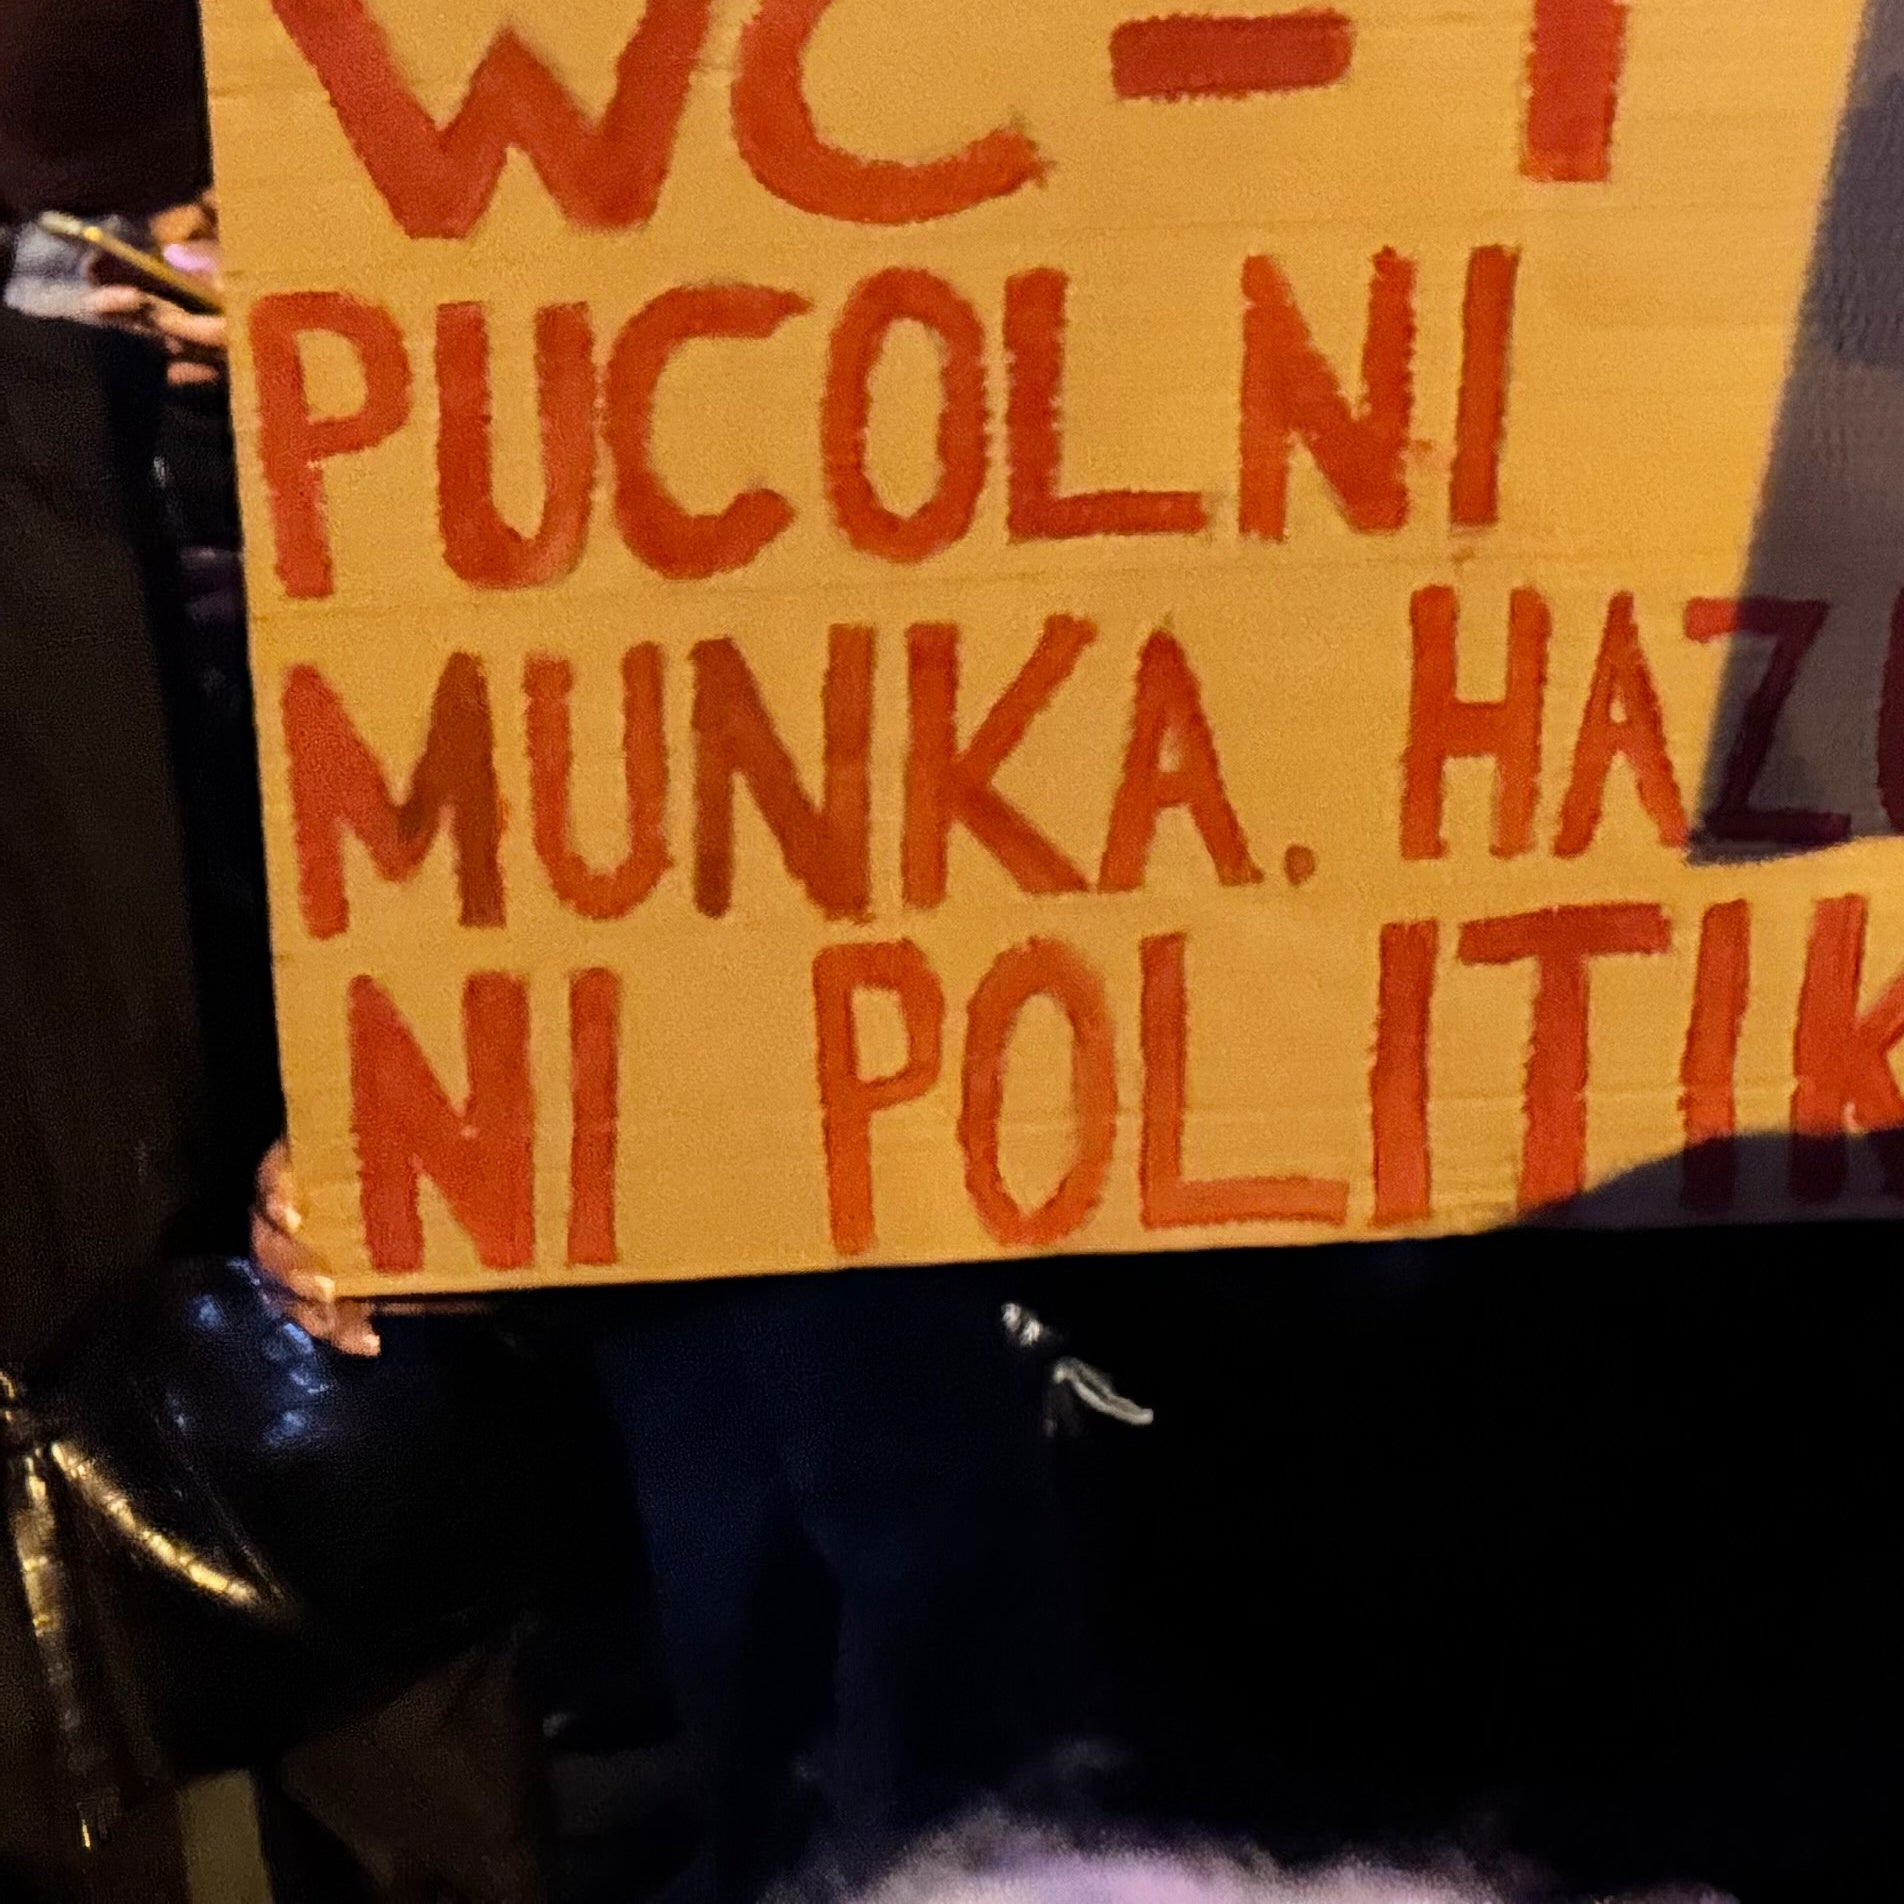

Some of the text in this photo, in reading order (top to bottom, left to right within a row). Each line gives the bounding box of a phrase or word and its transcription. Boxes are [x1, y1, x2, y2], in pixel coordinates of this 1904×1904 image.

[248, 245, 1521, 596] PUCOLNI
[278, 615, 1318, 939] MUNKA.
[347, 967, 619, 1271] NI
